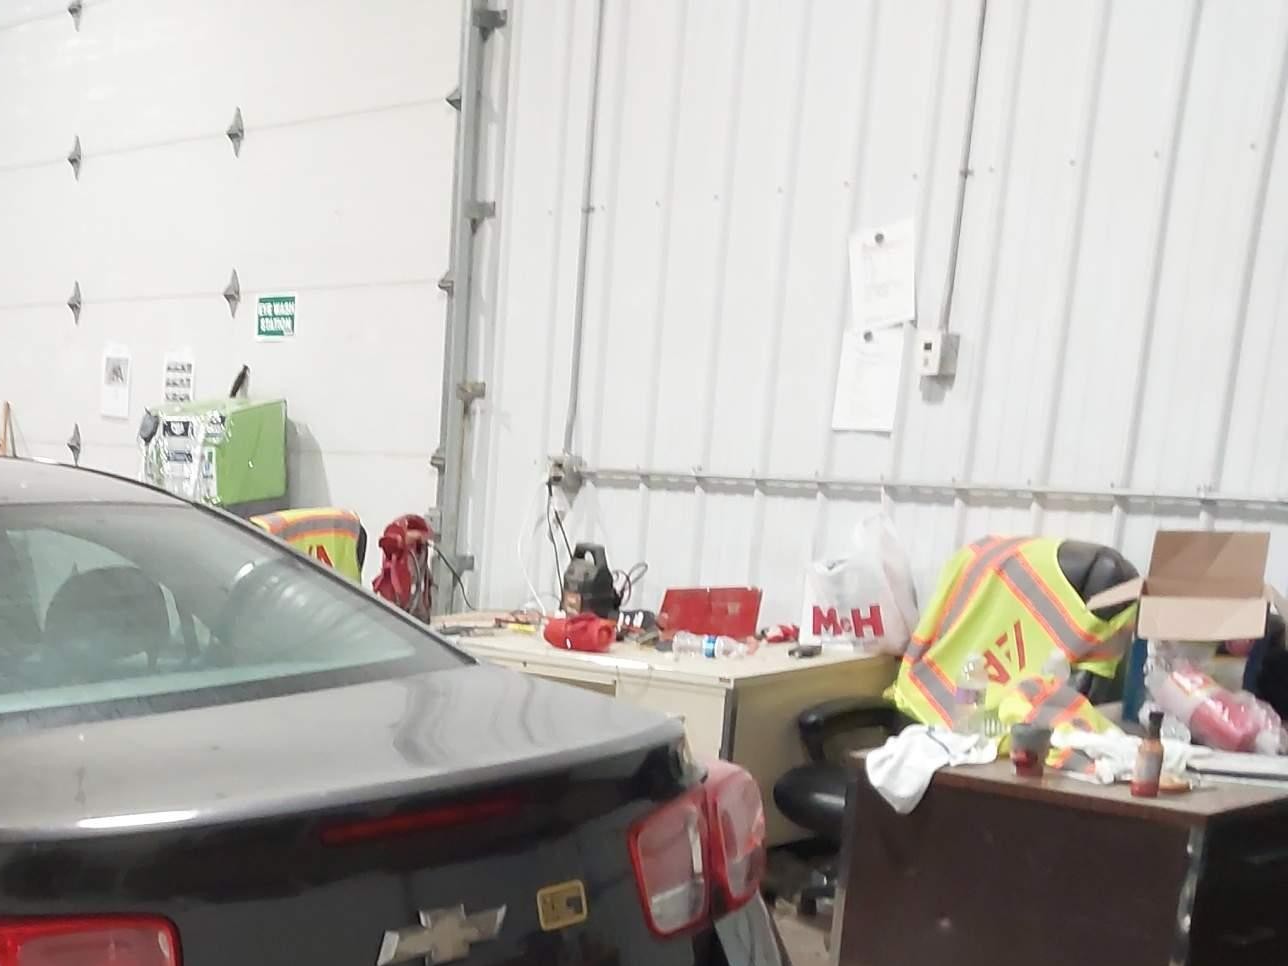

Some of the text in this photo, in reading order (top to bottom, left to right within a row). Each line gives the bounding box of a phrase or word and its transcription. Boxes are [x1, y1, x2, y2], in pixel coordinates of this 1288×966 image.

[258, 300, 295, 316] EYE WASH
[260, 316, 293, 331] STATION
